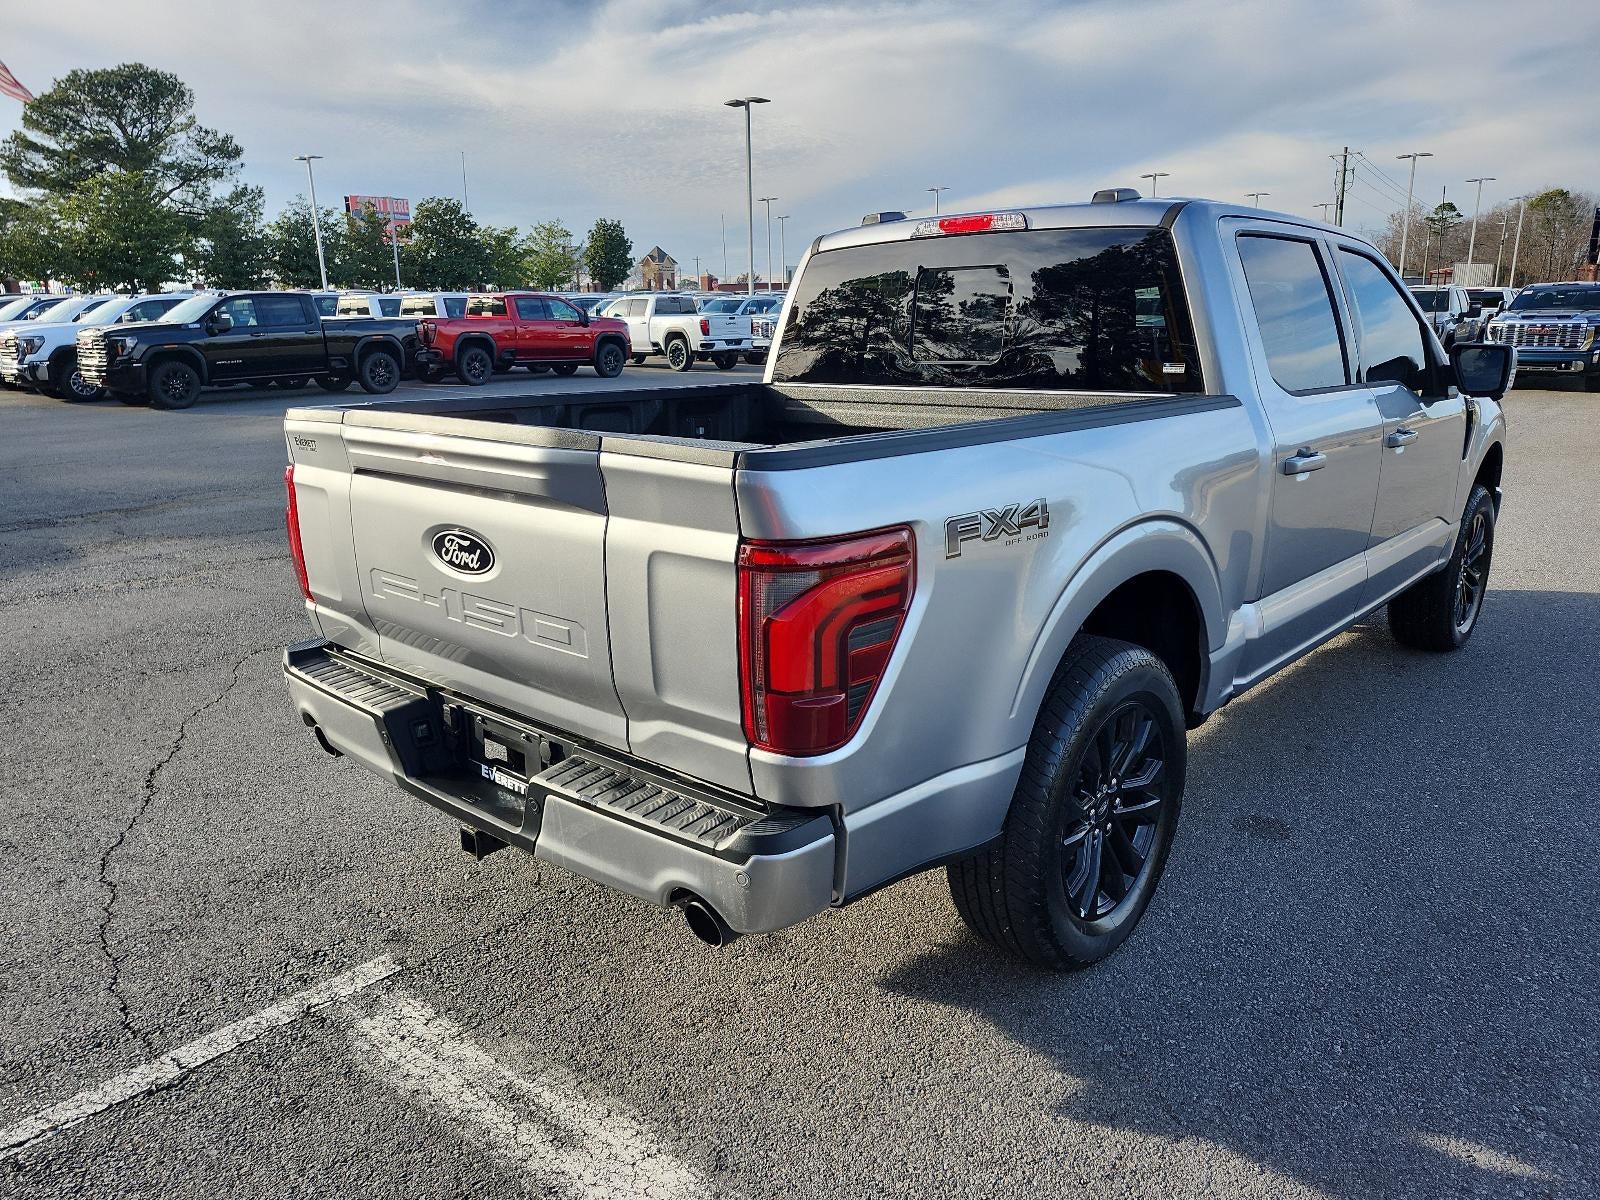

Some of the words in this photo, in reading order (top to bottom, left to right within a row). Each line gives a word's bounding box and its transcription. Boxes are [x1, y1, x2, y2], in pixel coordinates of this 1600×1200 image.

[944, 497, 1049, 560] FX4
[1005, 538, 1023, 547] OFF
[1027, 531, 1049, 541] ROAD
[441, 535, 481, 570] Ford
[370, 567, 590, 659] F-150
[481, 764, 527, 795] EVERETT
